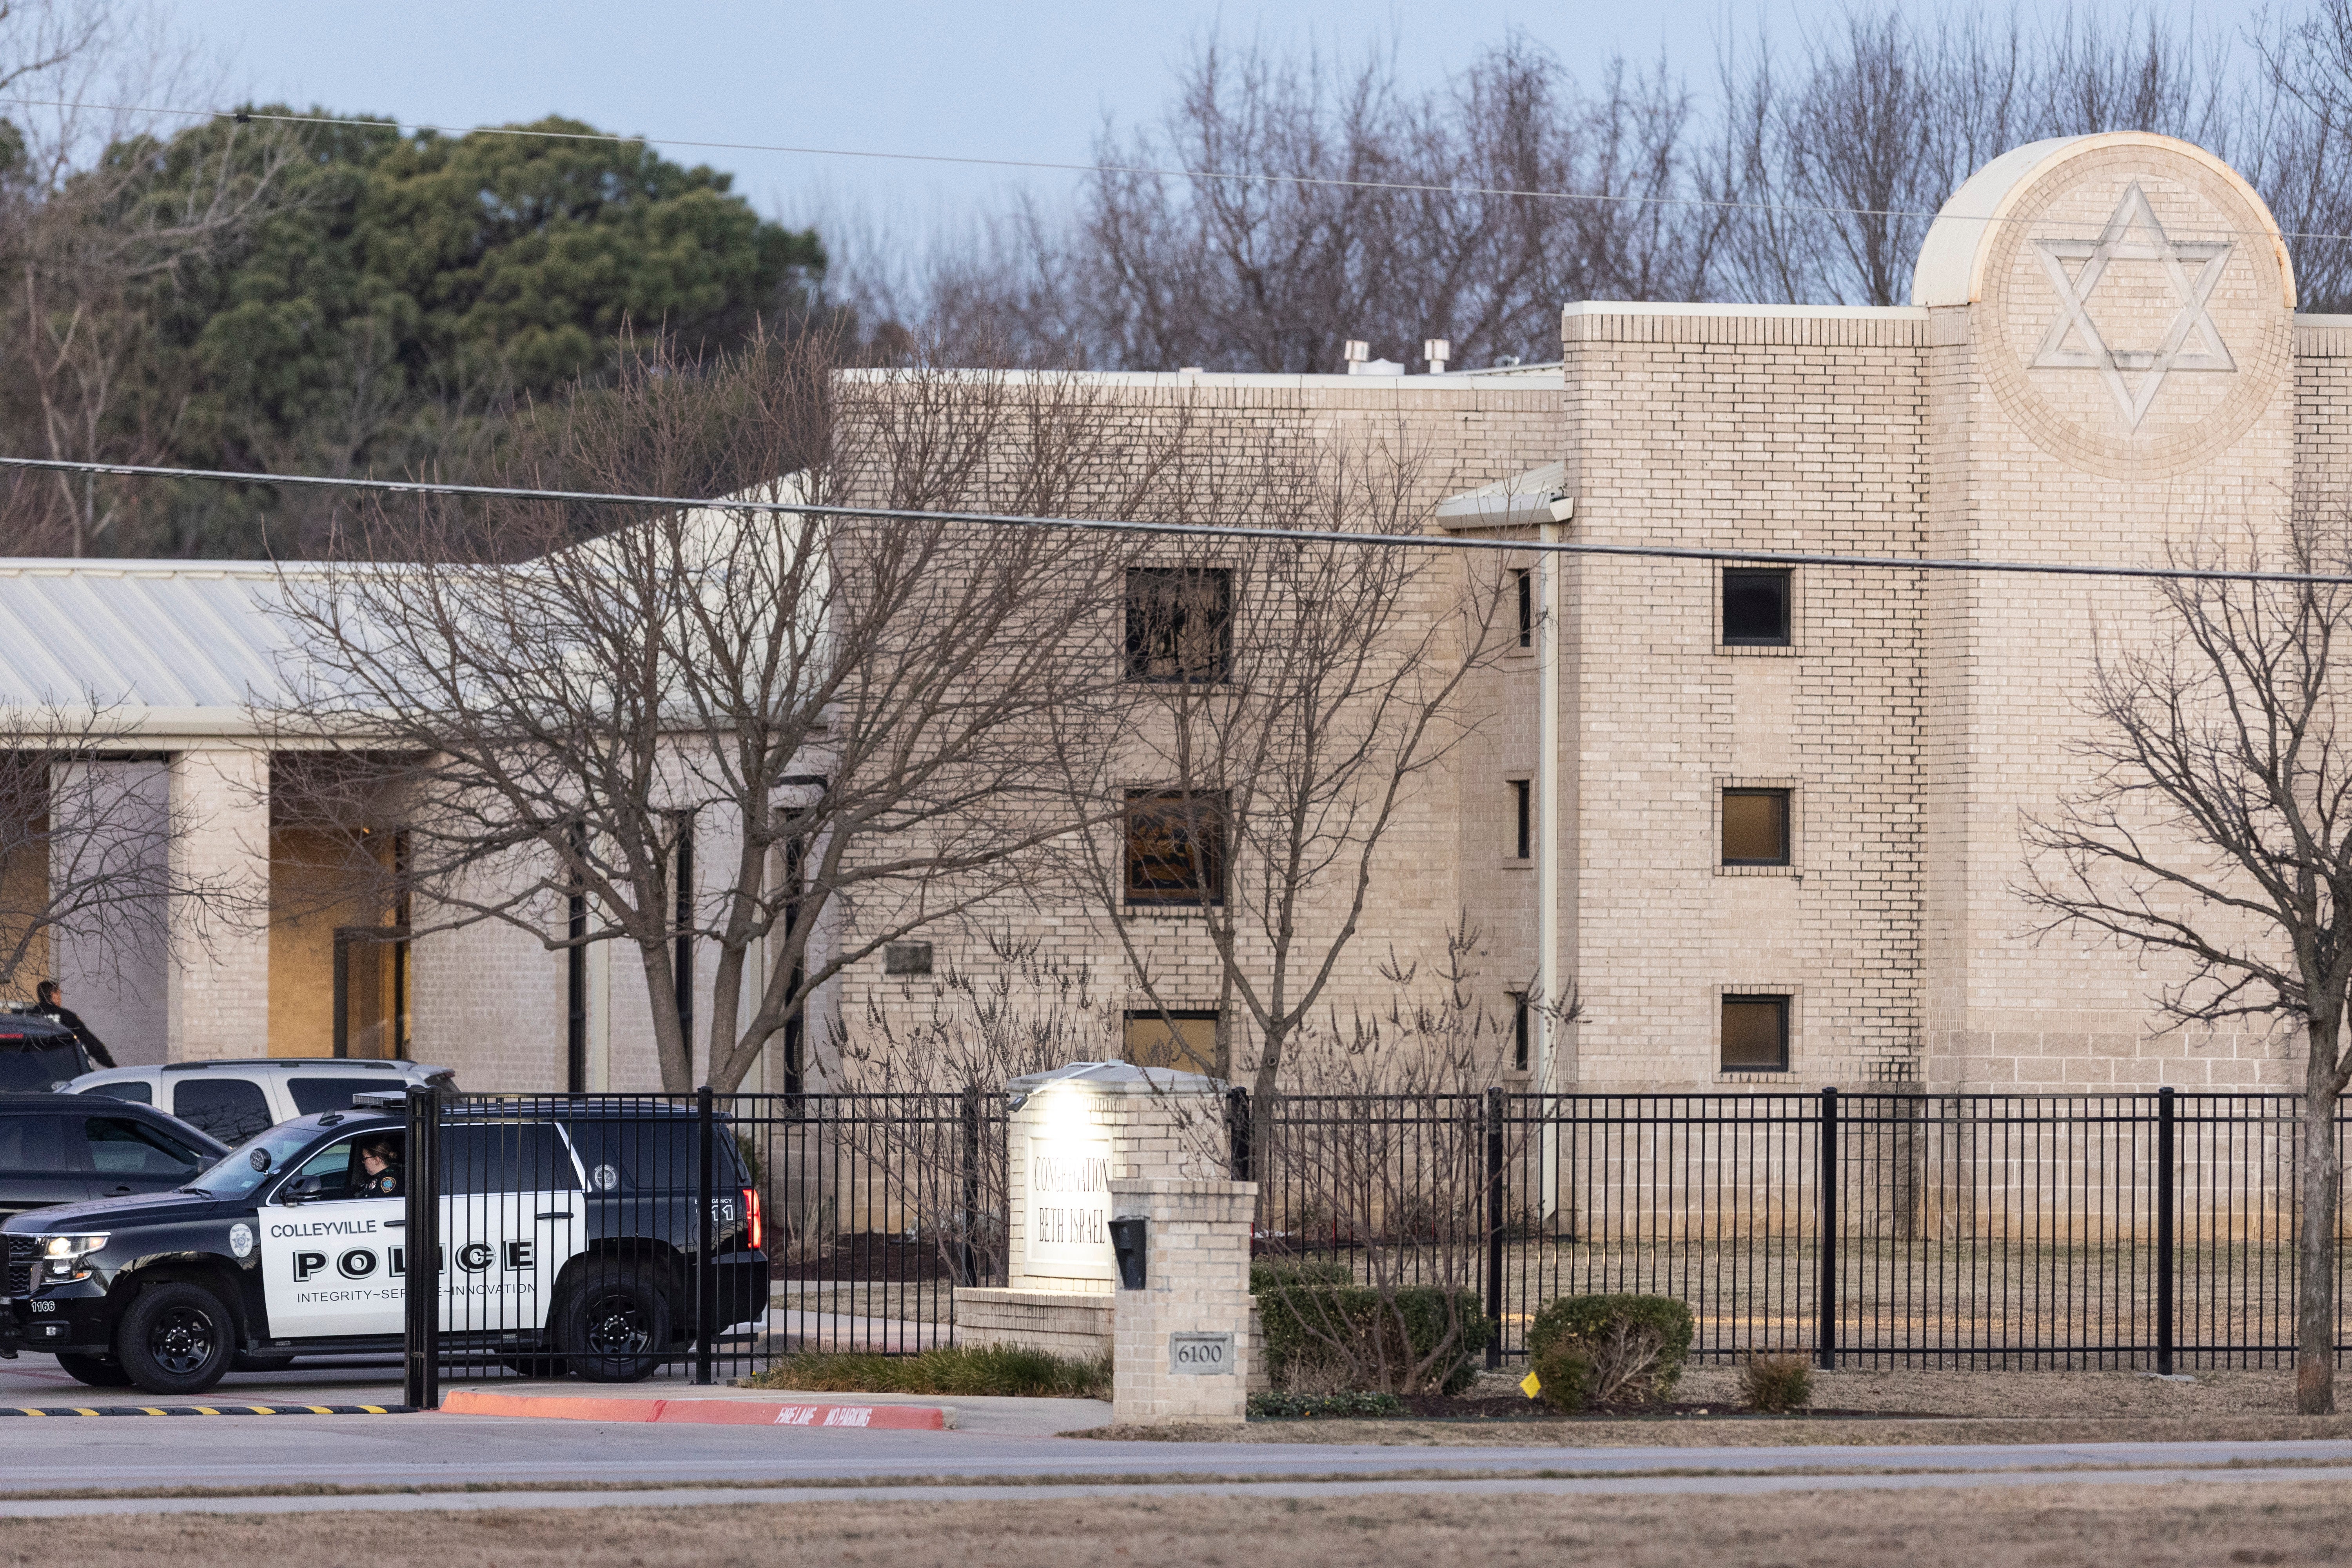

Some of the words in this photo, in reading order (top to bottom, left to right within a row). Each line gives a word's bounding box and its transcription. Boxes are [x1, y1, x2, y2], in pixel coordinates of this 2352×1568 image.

[696, 1205, 733, 1221] 11
[270, 1220, 377, 1238] COLLEYVILLE
[1039, 1207, 1063, 1242] BETH
[1070, 1209, 1105, 1243] ISRAEL
[31, 1301, 55, 1312] 1166
[1178, 1345, 1222, 1363] 6100
[774, 1406, 798, 1424] FIRE
